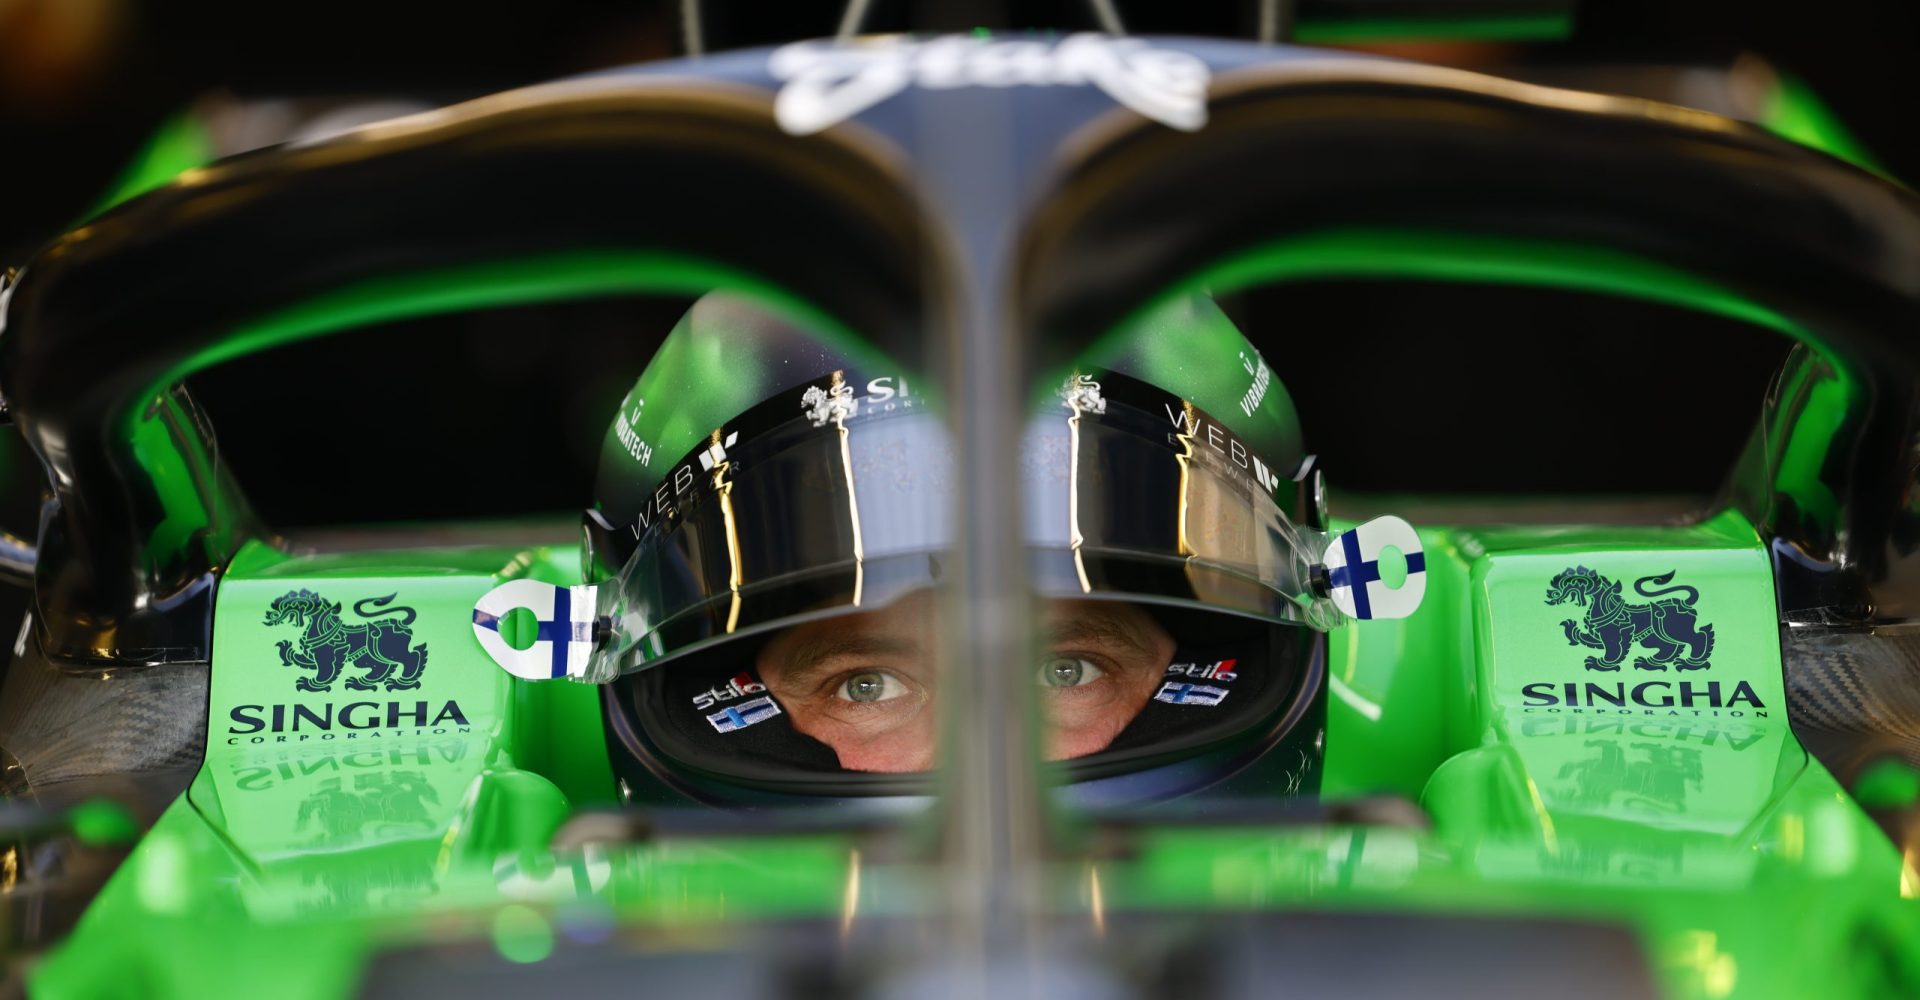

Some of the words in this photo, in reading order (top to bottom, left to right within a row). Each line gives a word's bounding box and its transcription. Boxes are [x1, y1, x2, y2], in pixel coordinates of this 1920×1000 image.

[1165, 403, 1248, 469] WEB
[631, 464, 693, 541] WEB
[1521, 680, 1766, 708] SINGHA
[228, 700, 471, 734] SINGHA
[1523, 707, 1768, 718] CORPORATION
[227, 727, 471, 746] CORPORATION
